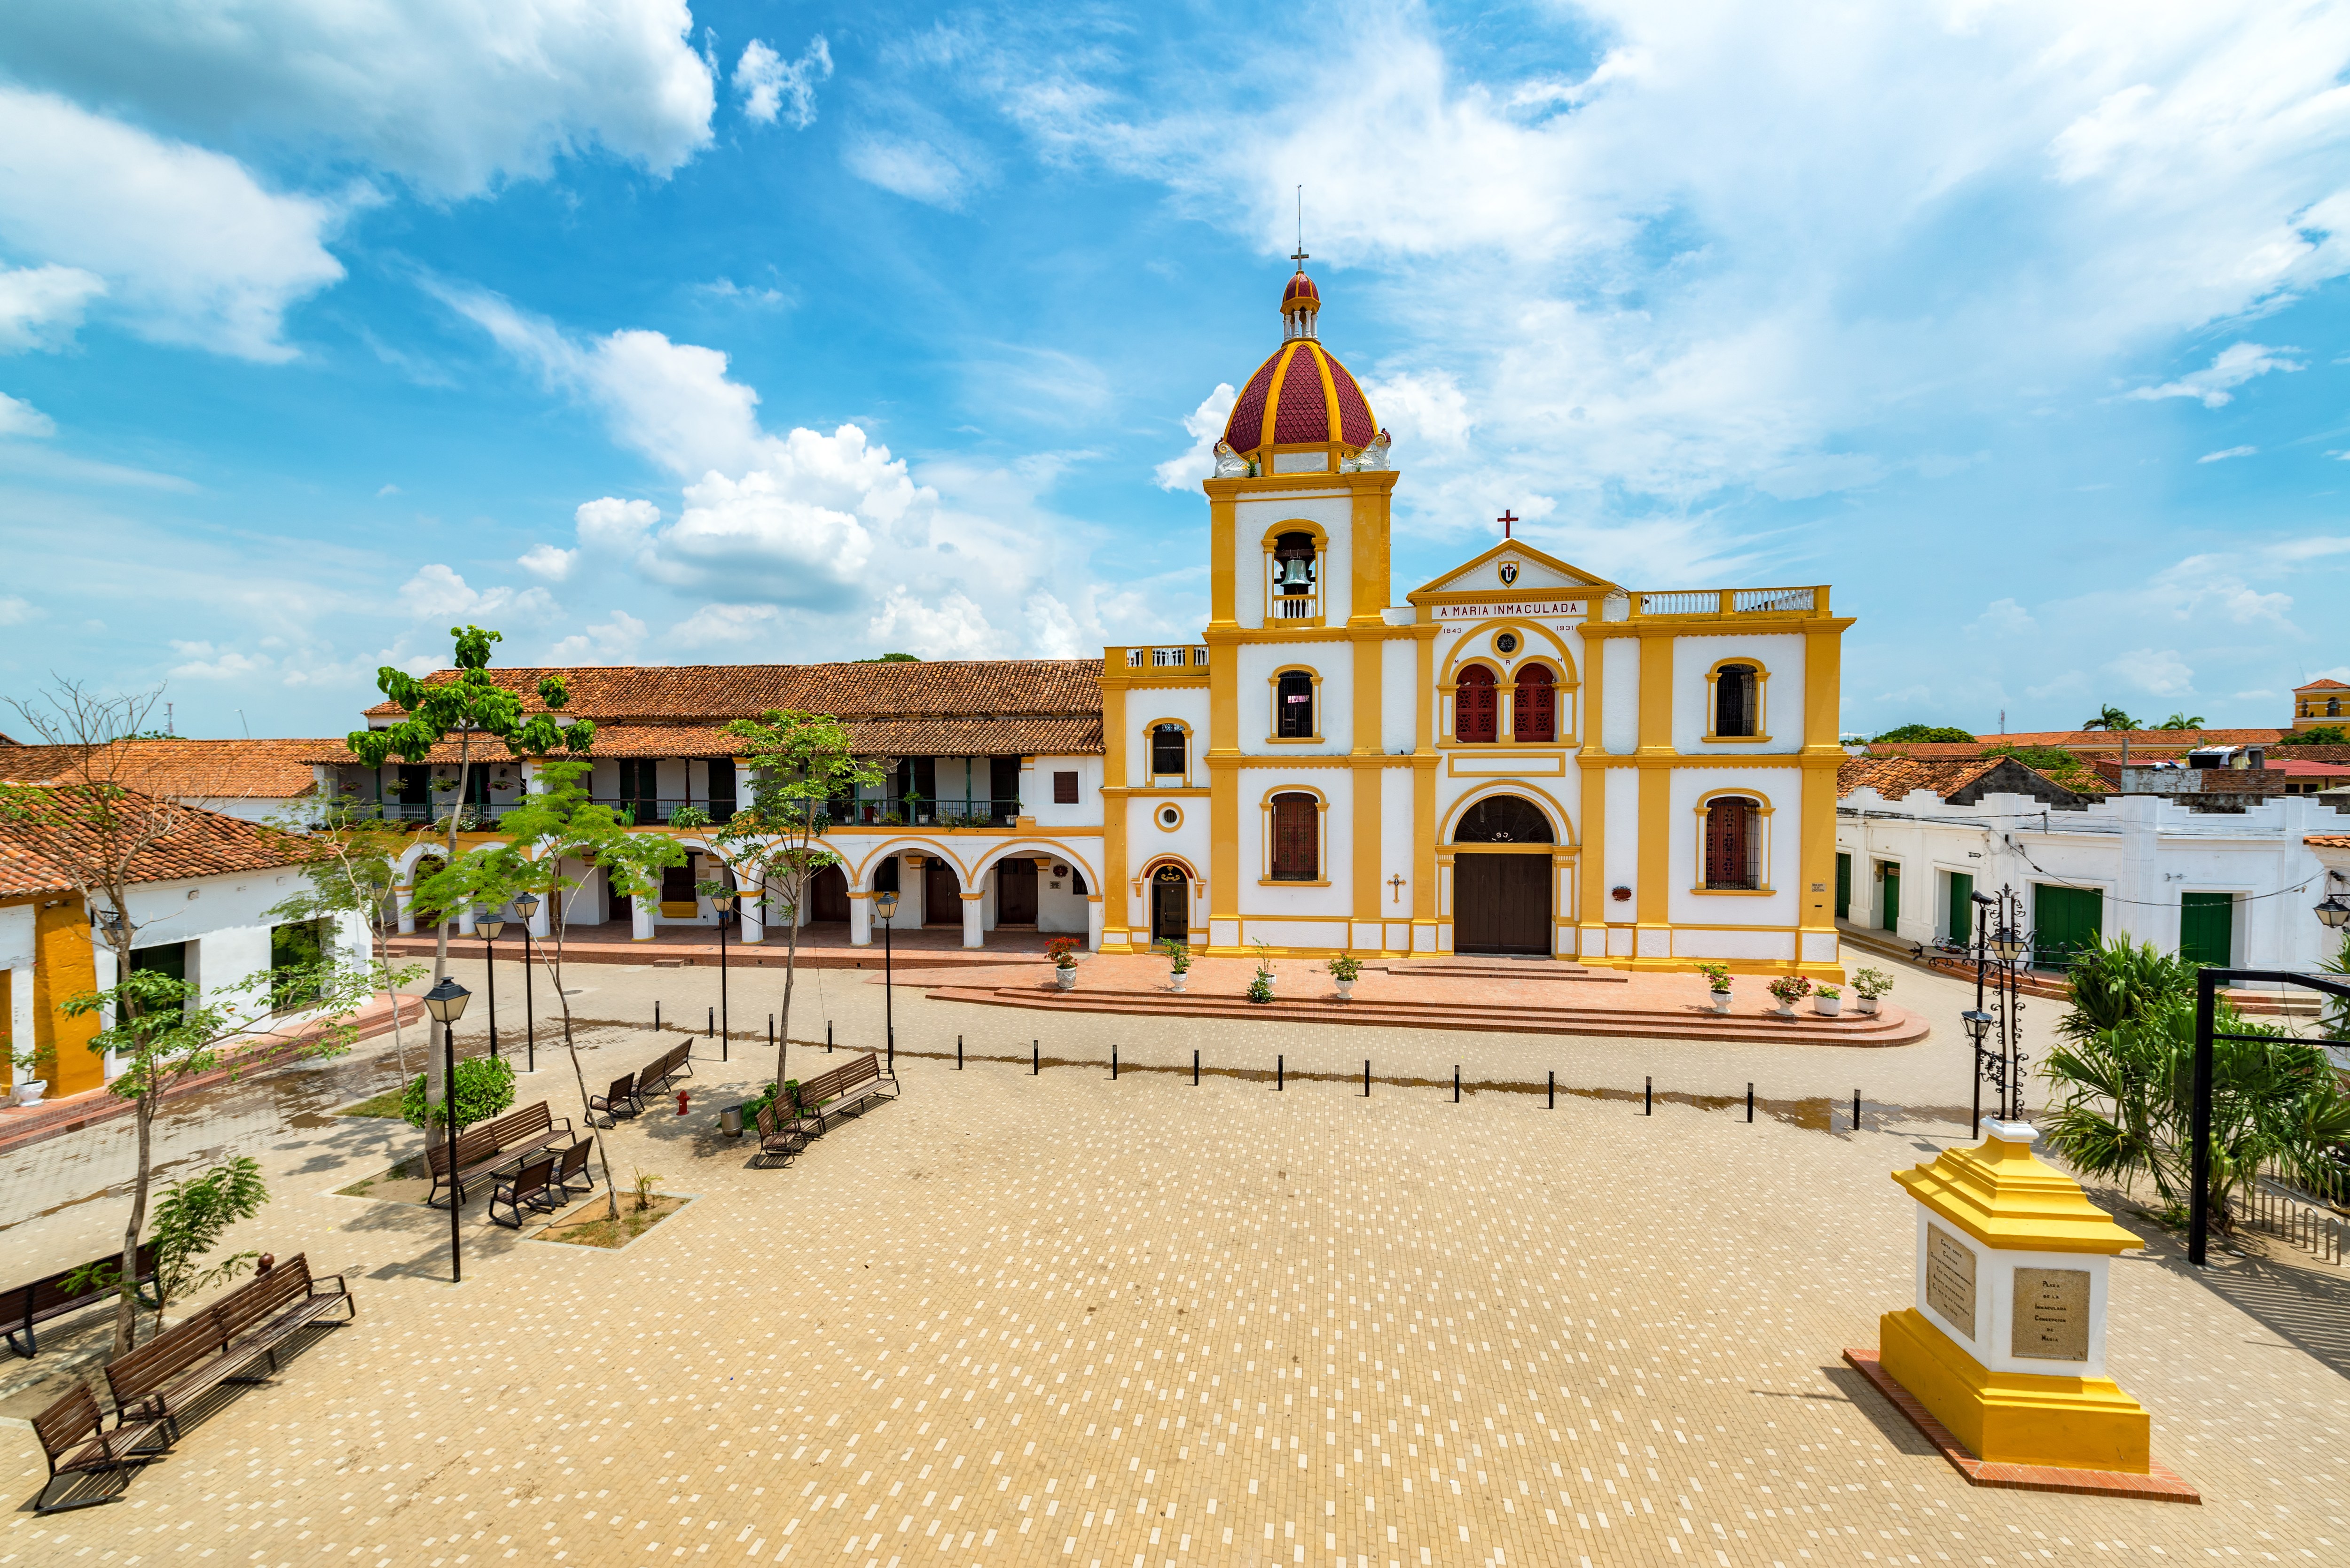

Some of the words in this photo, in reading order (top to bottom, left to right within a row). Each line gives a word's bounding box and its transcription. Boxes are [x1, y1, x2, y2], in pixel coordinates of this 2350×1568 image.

[1441, 607, 1447, 616] A
[1453, 605, 1489, 616] MARIA
[1494, 603, 1577, 615] INMACULADA
